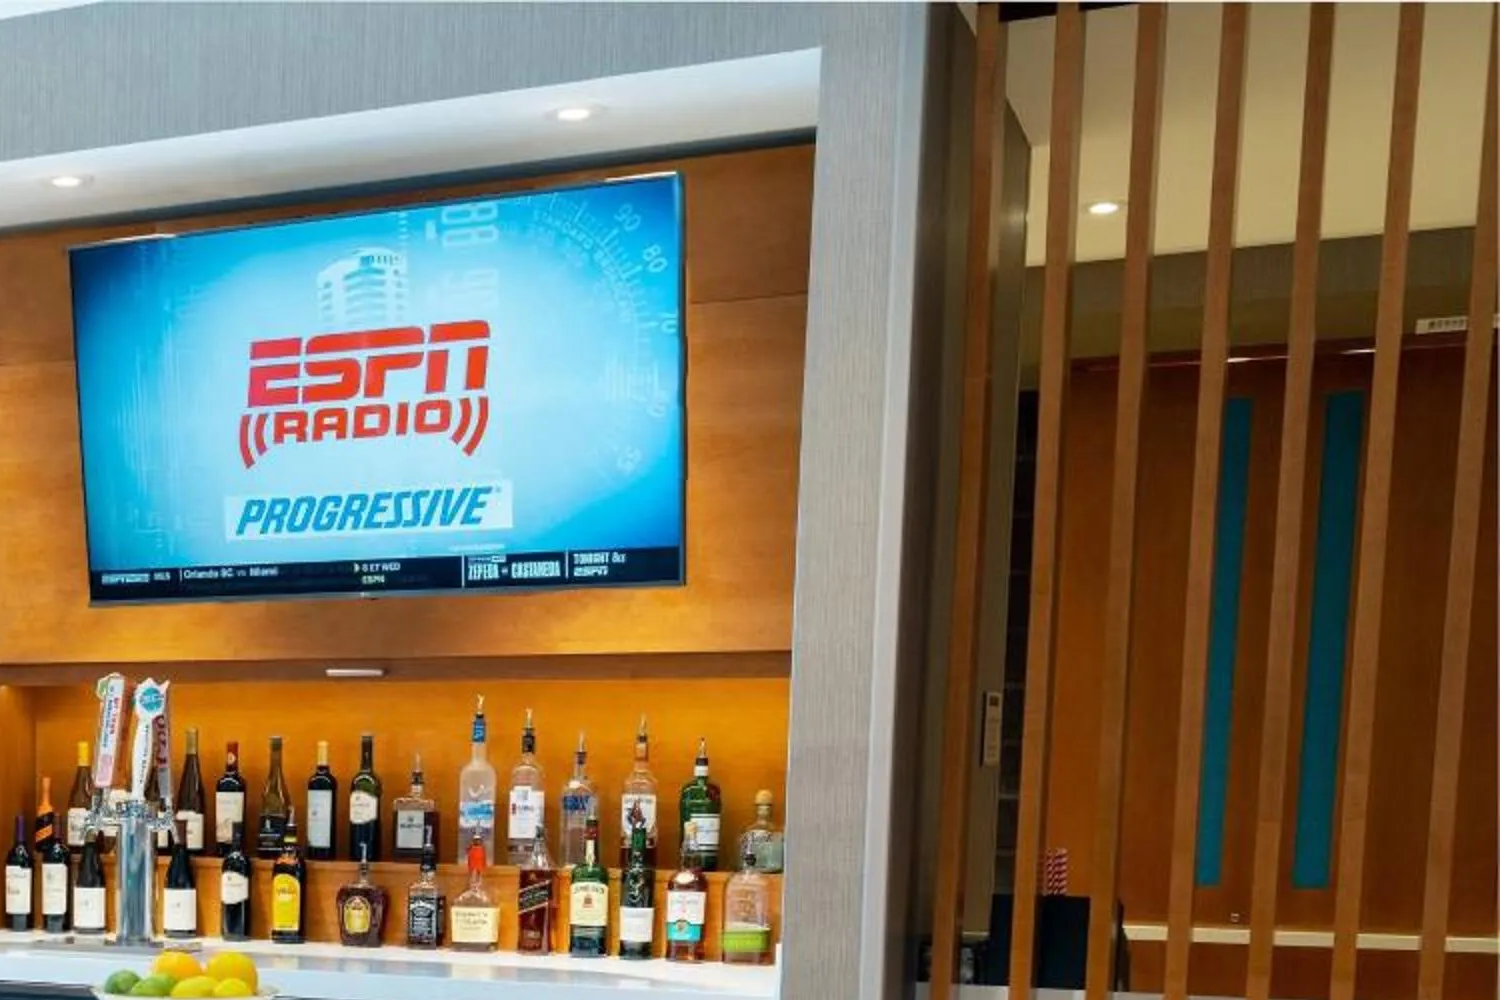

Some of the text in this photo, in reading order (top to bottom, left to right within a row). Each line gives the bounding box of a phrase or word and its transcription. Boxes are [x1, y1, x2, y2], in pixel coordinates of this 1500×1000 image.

[247, 319, 491, 408] ESPN
[273, 398, 453, 444] RADIO
[235, 485, 493, 536] PROGRESSIVE
[184, 569, 218, 580] Orlando
